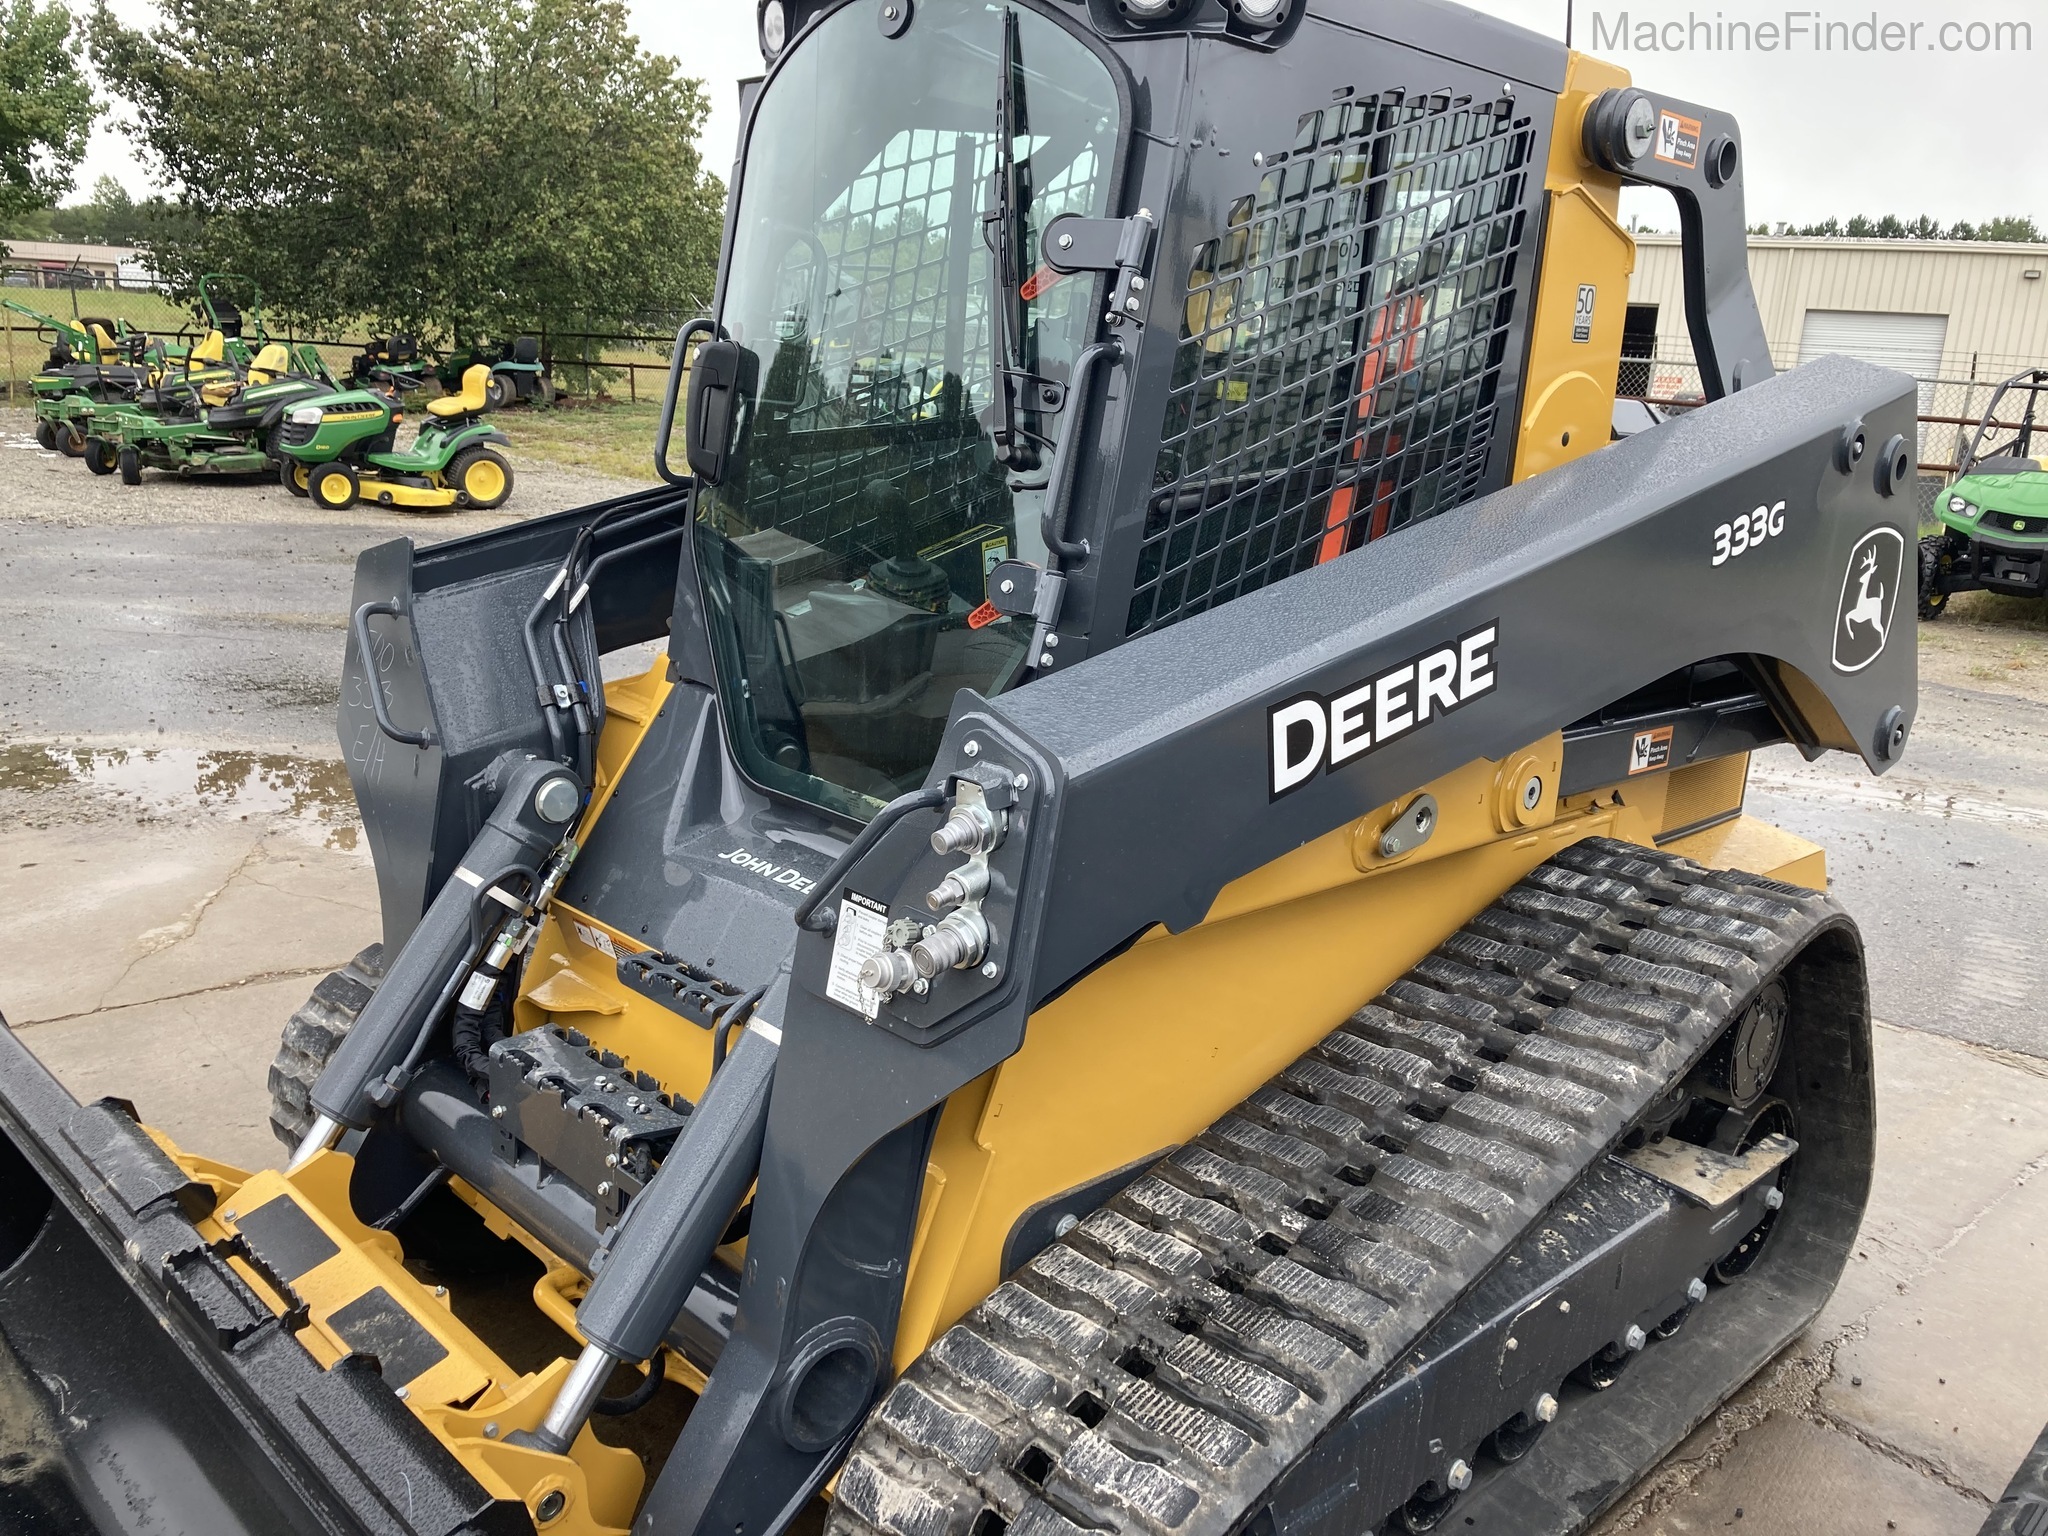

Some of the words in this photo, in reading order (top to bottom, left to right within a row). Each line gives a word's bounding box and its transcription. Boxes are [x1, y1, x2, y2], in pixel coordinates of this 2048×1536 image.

[1576, 287, 1594, 315] 50
[1575, 315, 1591, 325] YEARS
[1712, 500, 1786, 566] 333G
[1272, 626, 1496, 795] DEERE
[717, 847, 781, 877] JOHN
[850, 892, 888, 915] IMPORTANT
